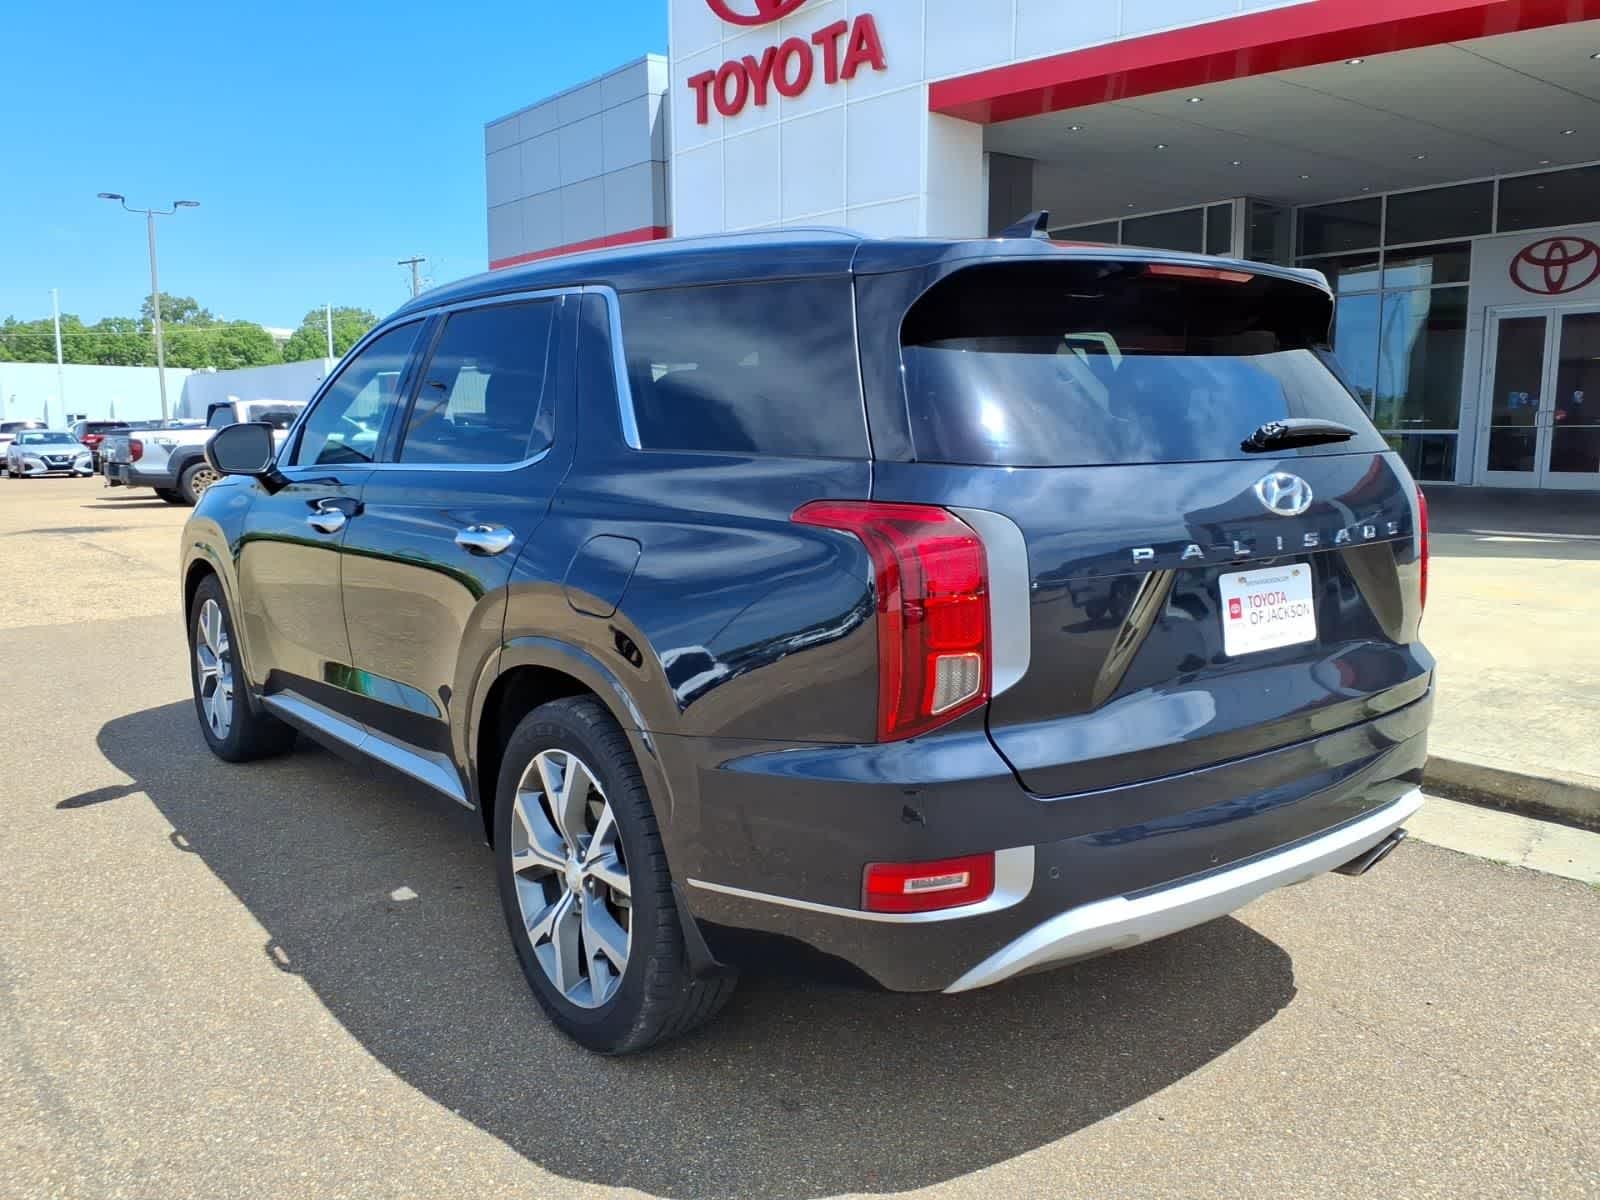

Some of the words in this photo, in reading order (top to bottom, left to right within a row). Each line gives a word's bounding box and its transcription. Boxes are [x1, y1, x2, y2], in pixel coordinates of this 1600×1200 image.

[687, 13, 888, 125] TOYOTA
[1131, 521, 1400, 564] PALISADE
[1248, 592, 1287, 608] TOYOTA
[1250, 611, 1264, 625] OF
[1267, 604, 1310, 623] JACKSON
